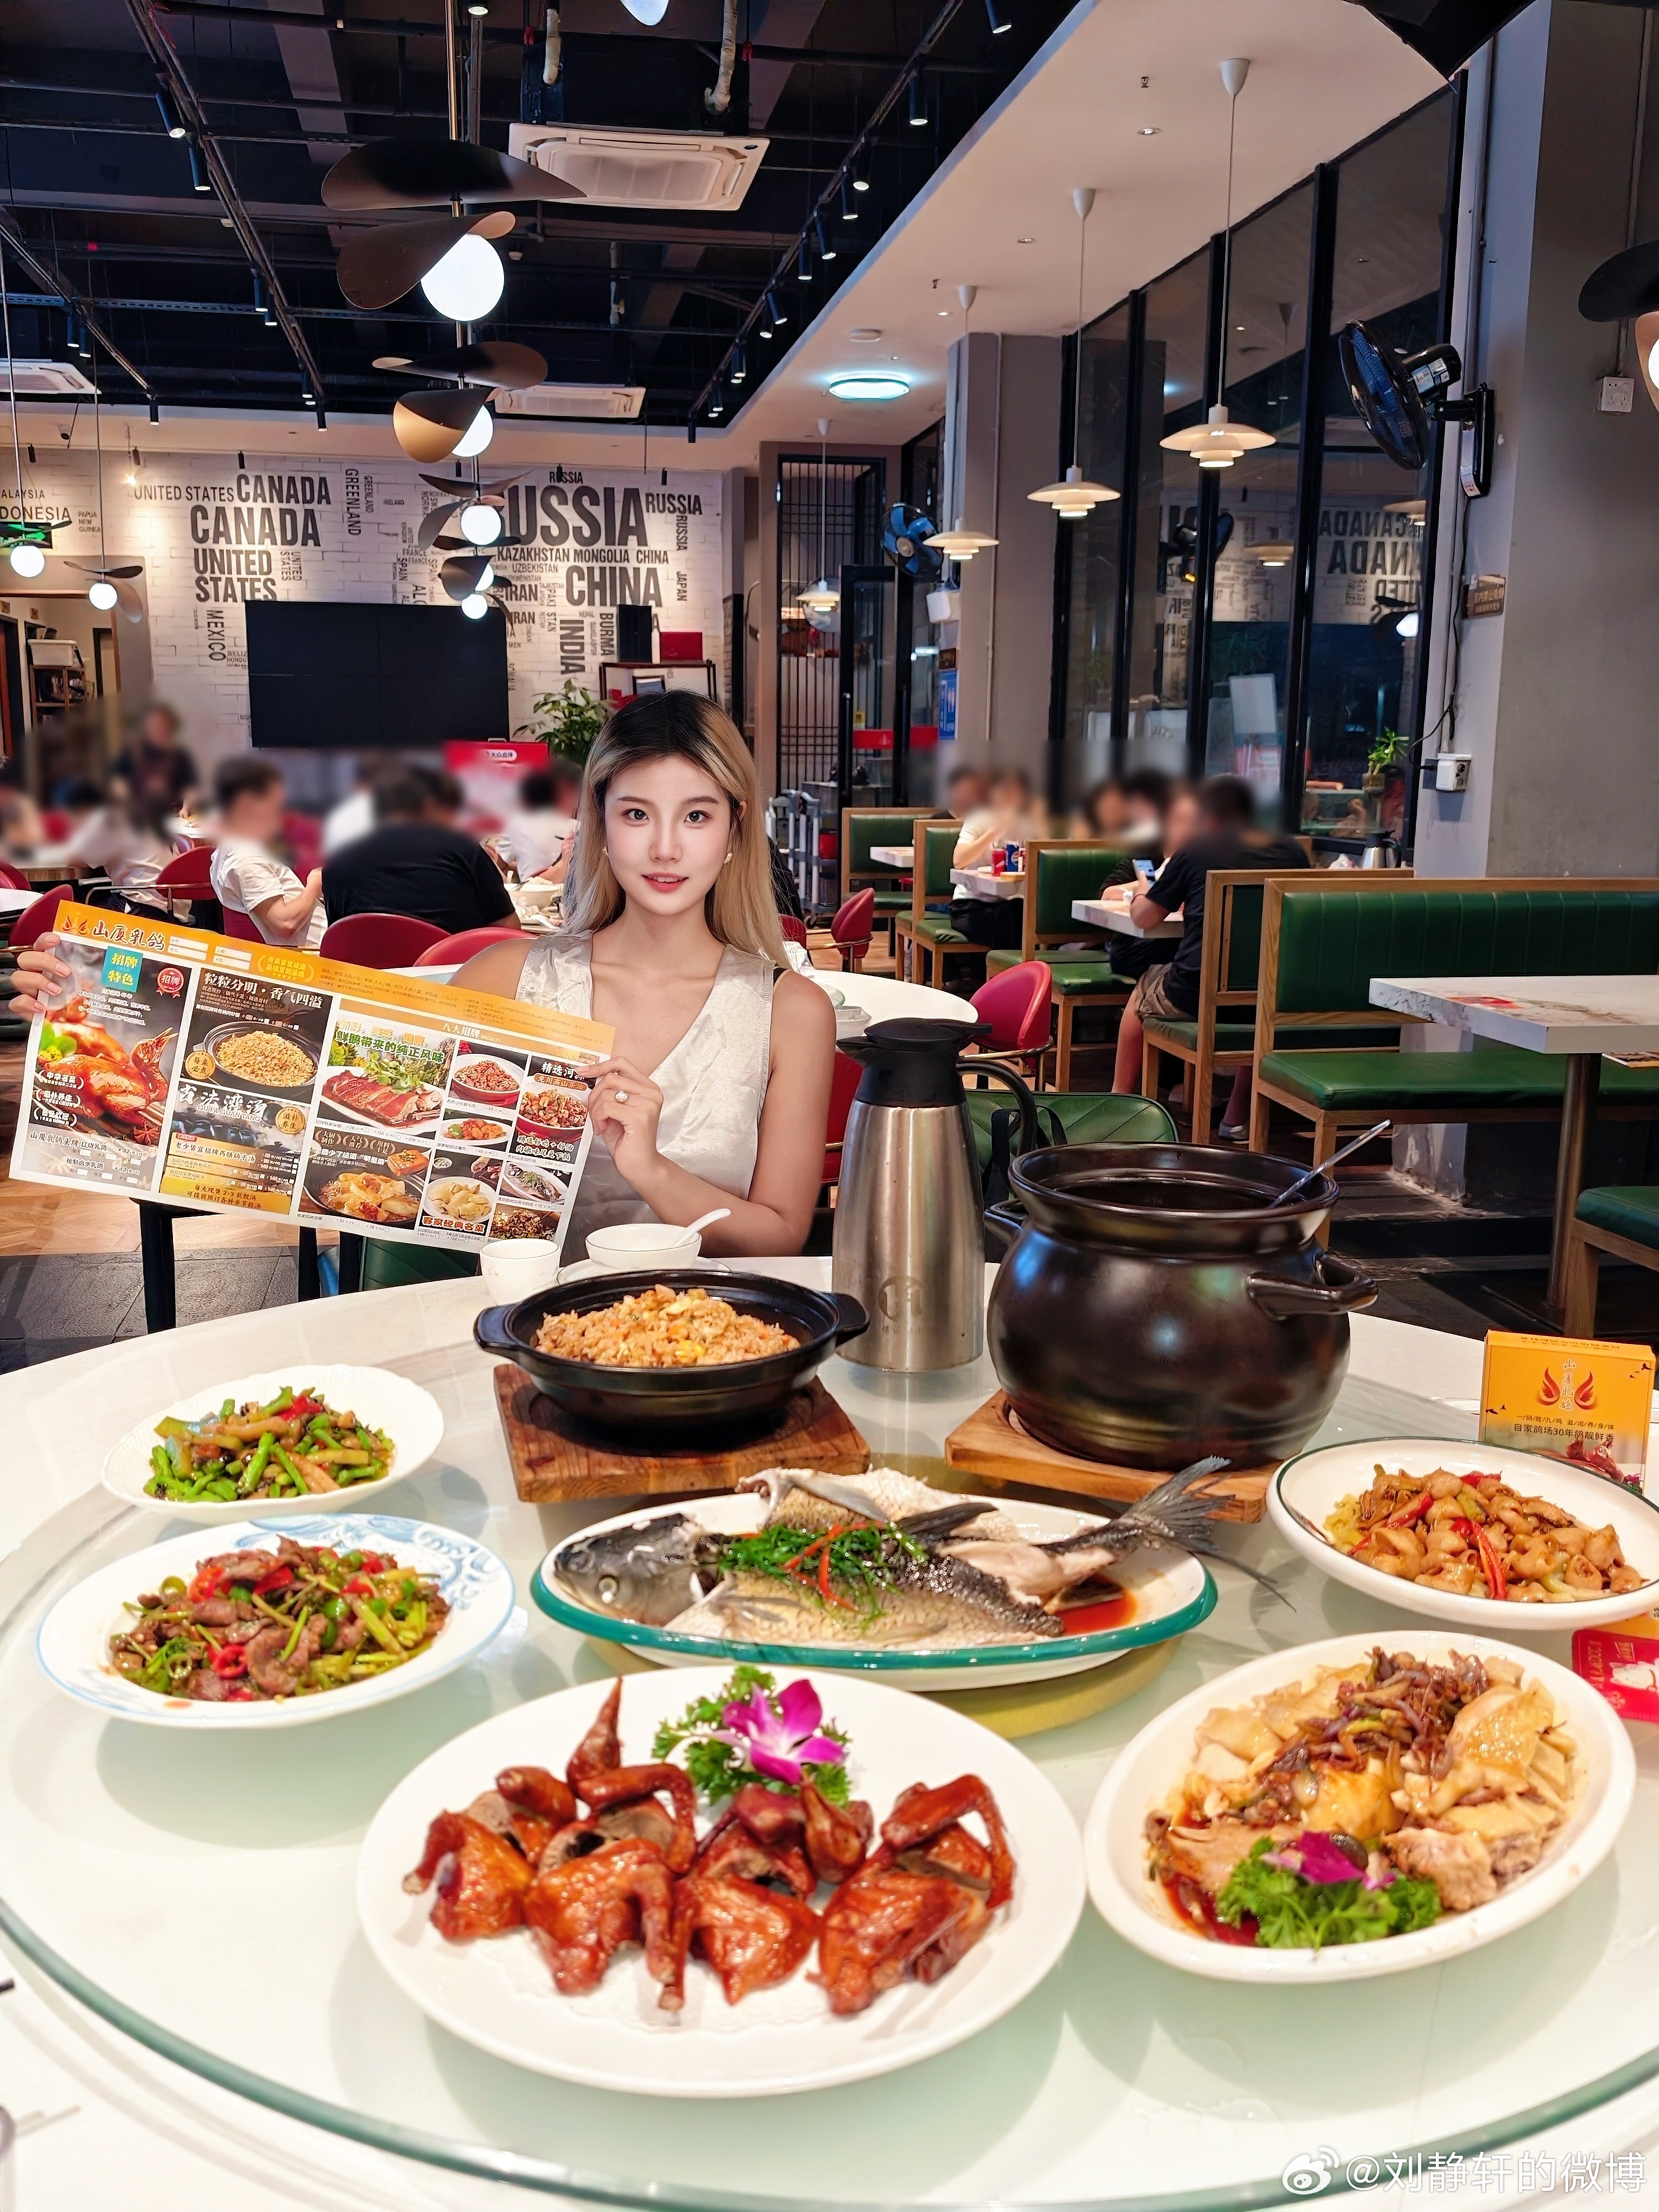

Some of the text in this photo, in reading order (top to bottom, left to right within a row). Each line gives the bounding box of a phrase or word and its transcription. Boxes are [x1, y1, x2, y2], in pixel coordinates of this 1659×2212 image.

[1, 490, 45, 499] ALAYSIA
[134, 473, 331, 505] UNITED STATES CANADA
[345, 469, 361, 535] GREENLAND
[364, 476, 374, 513] GREENLAND
[645, 492, 703, 515] RUSSIA
[0, 505, 71, 520] DONESIA
[190, 505, 321, 547] CANADA
[500, 485, 647, 547] USSIA
[677, 514, 688, 551] RUSSIA
[194, 548, 272, 576] UNITED
[280, 551, 291, 581] STATES
[291, 551, 302, 581] UNITED
[403, 548, 427, 557] FRANCE
[497, 546, 669, 564] KAZAKHSTAN MONGOLIA CHINA
[512, 563, 558, 573] UZBEKISTAN
[195, 576, 277, 603] STATES
[505, 584, 538, 602] IRAN
[566, 565, 663, 607] CHINA
[677, 571, 688, 602] JAPAN
[206, 610, 226, 661] MEXICO
[560, 619, 585, 676] INDIA
[600, 613, 615, 656] BURMA
[92, 920, 166, 951] 山厦乳鸽
[111, 953, 138, 968] 招牌
[108, 970, 133, 986] 特色
[161, 974, 180, 987] 招牌
[441, 1022, 480, 1038] 八大招牌
[335, 1030, 445, 1063] 鲜鹅带来的纯正风味
